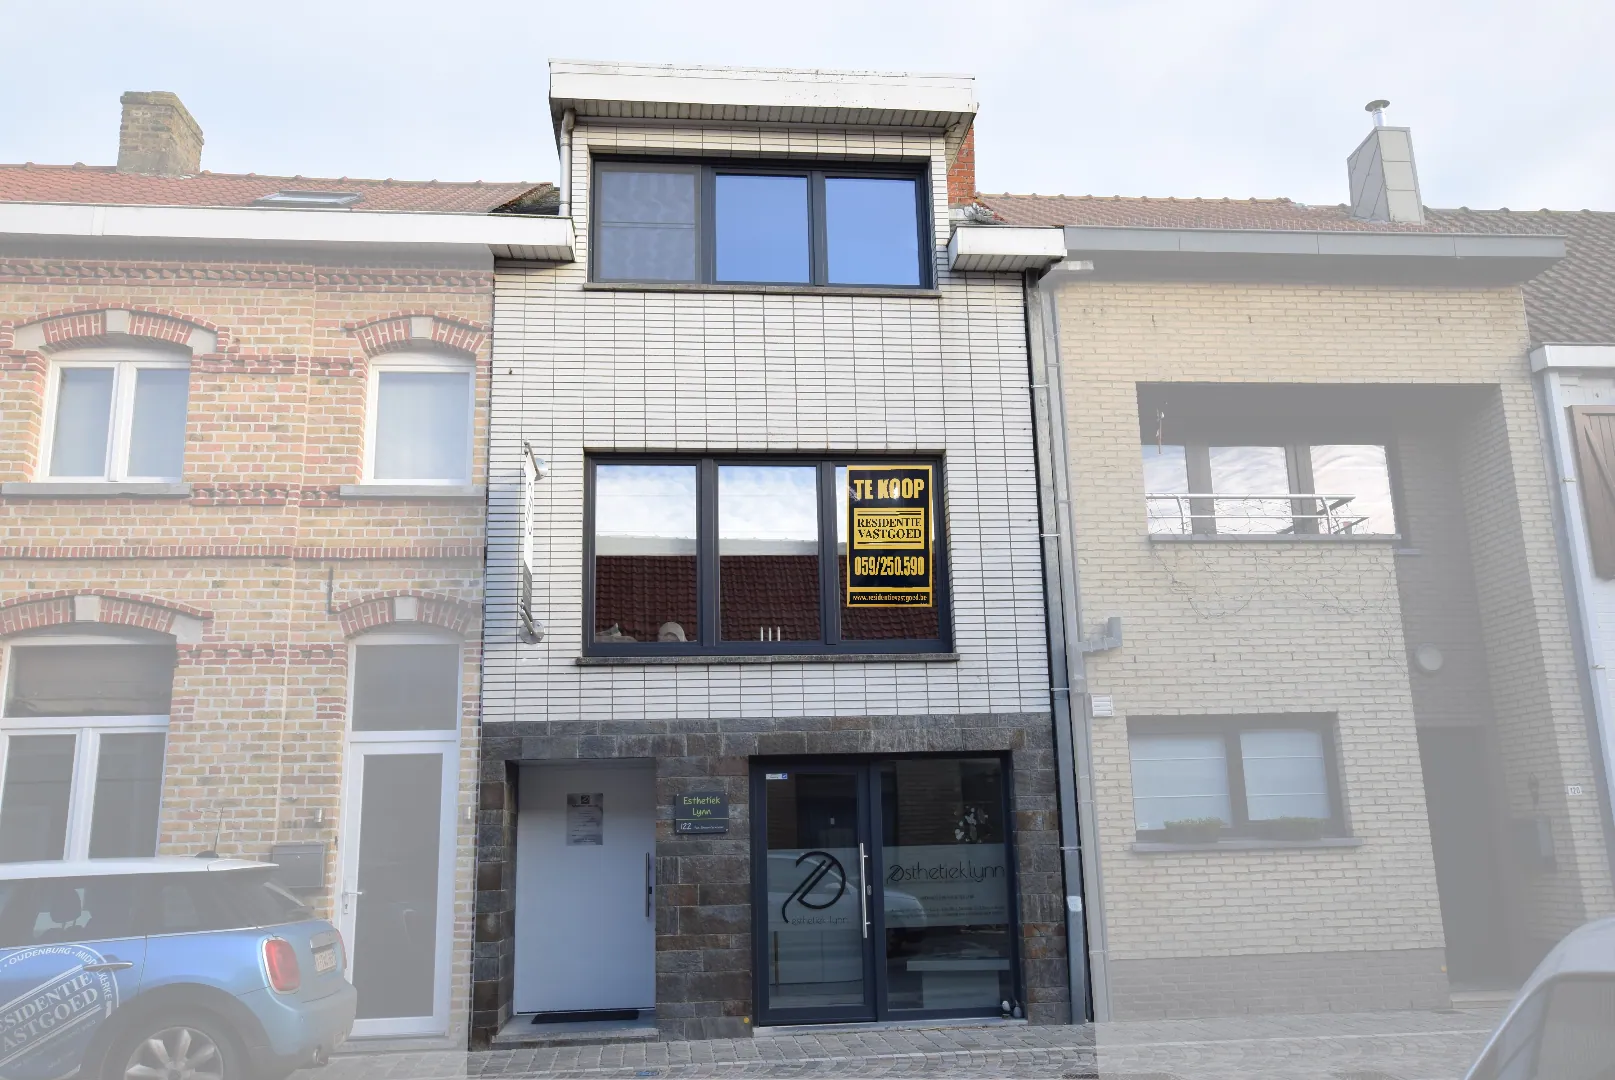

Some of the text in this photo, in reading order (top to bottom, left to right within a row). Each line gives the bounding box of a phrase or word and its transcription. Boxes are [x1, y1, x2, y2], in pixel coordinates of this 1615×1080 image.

[854, 477, 925, 500] TE KOOP
[857, 517, 922, 528] RESIDENTIE
[857, 528, 922, 540] VASTGOED
[854, 556, 925, 576] 059/250.590
[683, 796, 721, 805] Esthetiek
[692, 807, 712, 818] Lynn
[680, 822, 692, 830] 122
[8, 947, 113, 1001] OUDENBURG MIDDLKERKE
